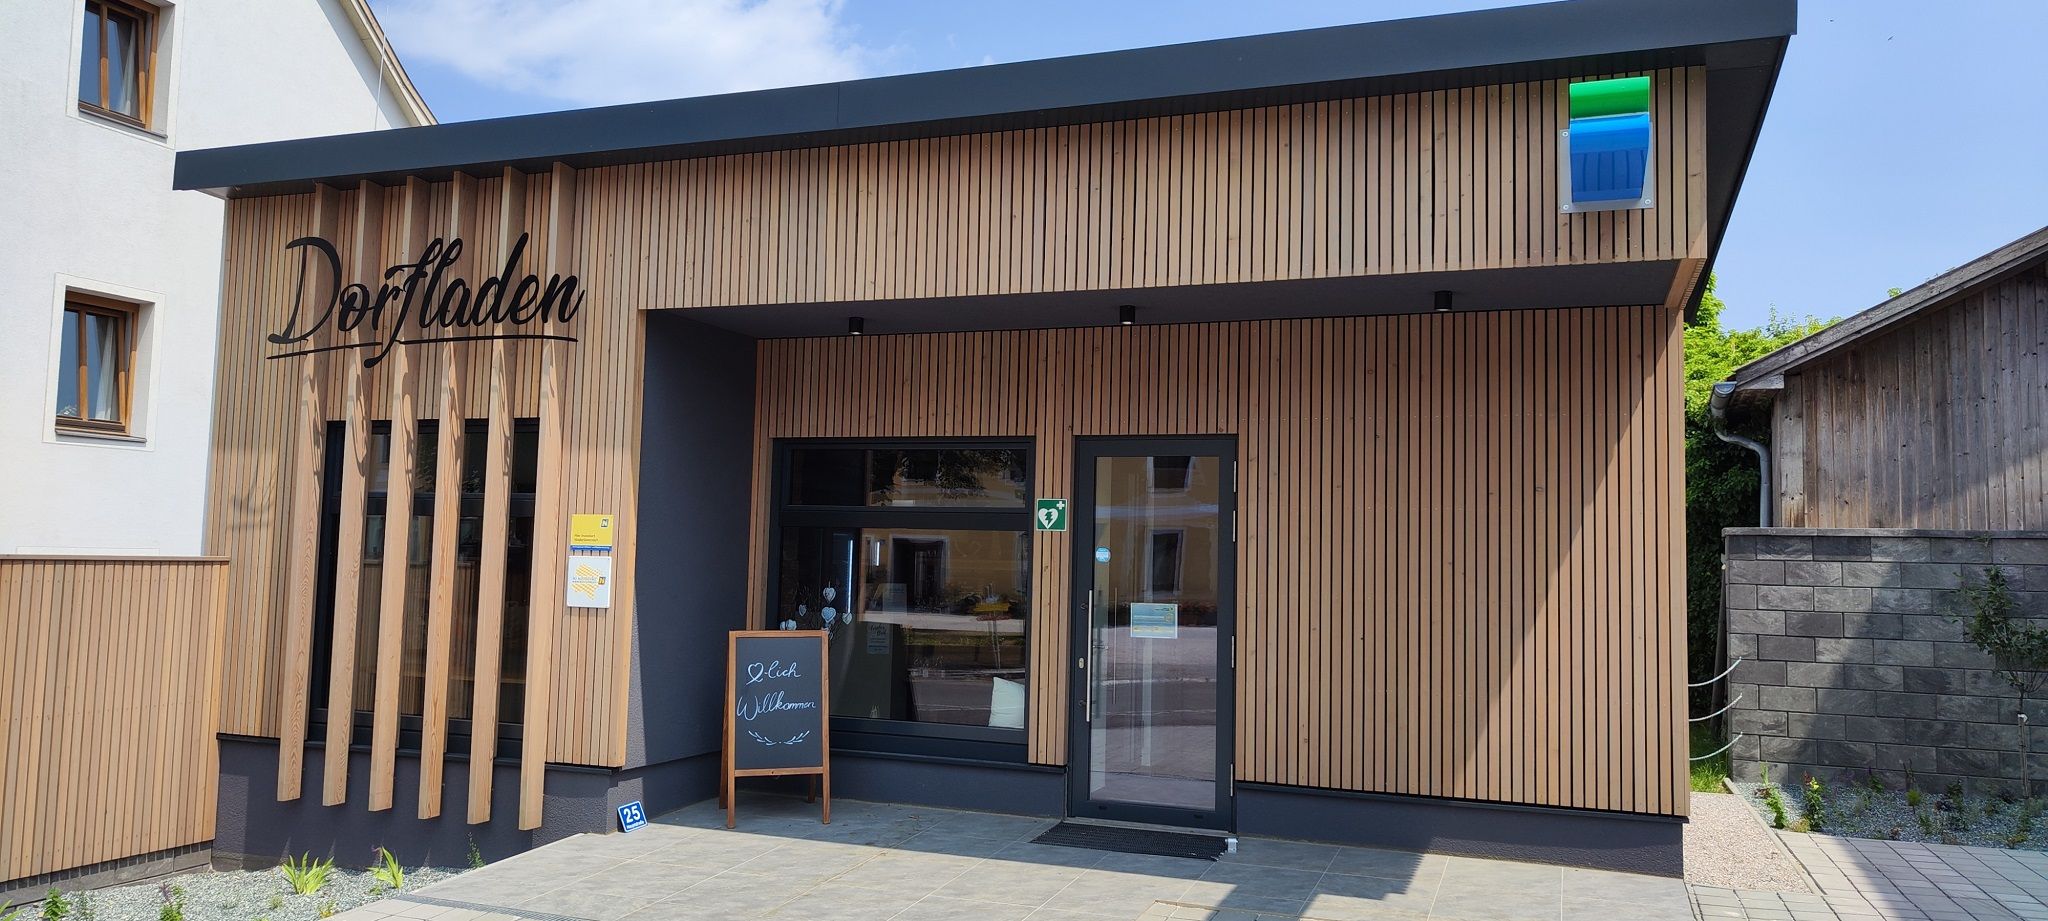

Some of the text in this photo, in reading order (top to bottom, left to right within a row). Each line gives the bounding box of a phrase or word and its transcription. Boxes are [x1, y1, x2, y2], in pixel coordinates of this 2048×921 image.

[267, 231, 586, 368] Dorfladen
[736, 690, 817, 721] Willkommen
[623, 805, 641, 824] 25
